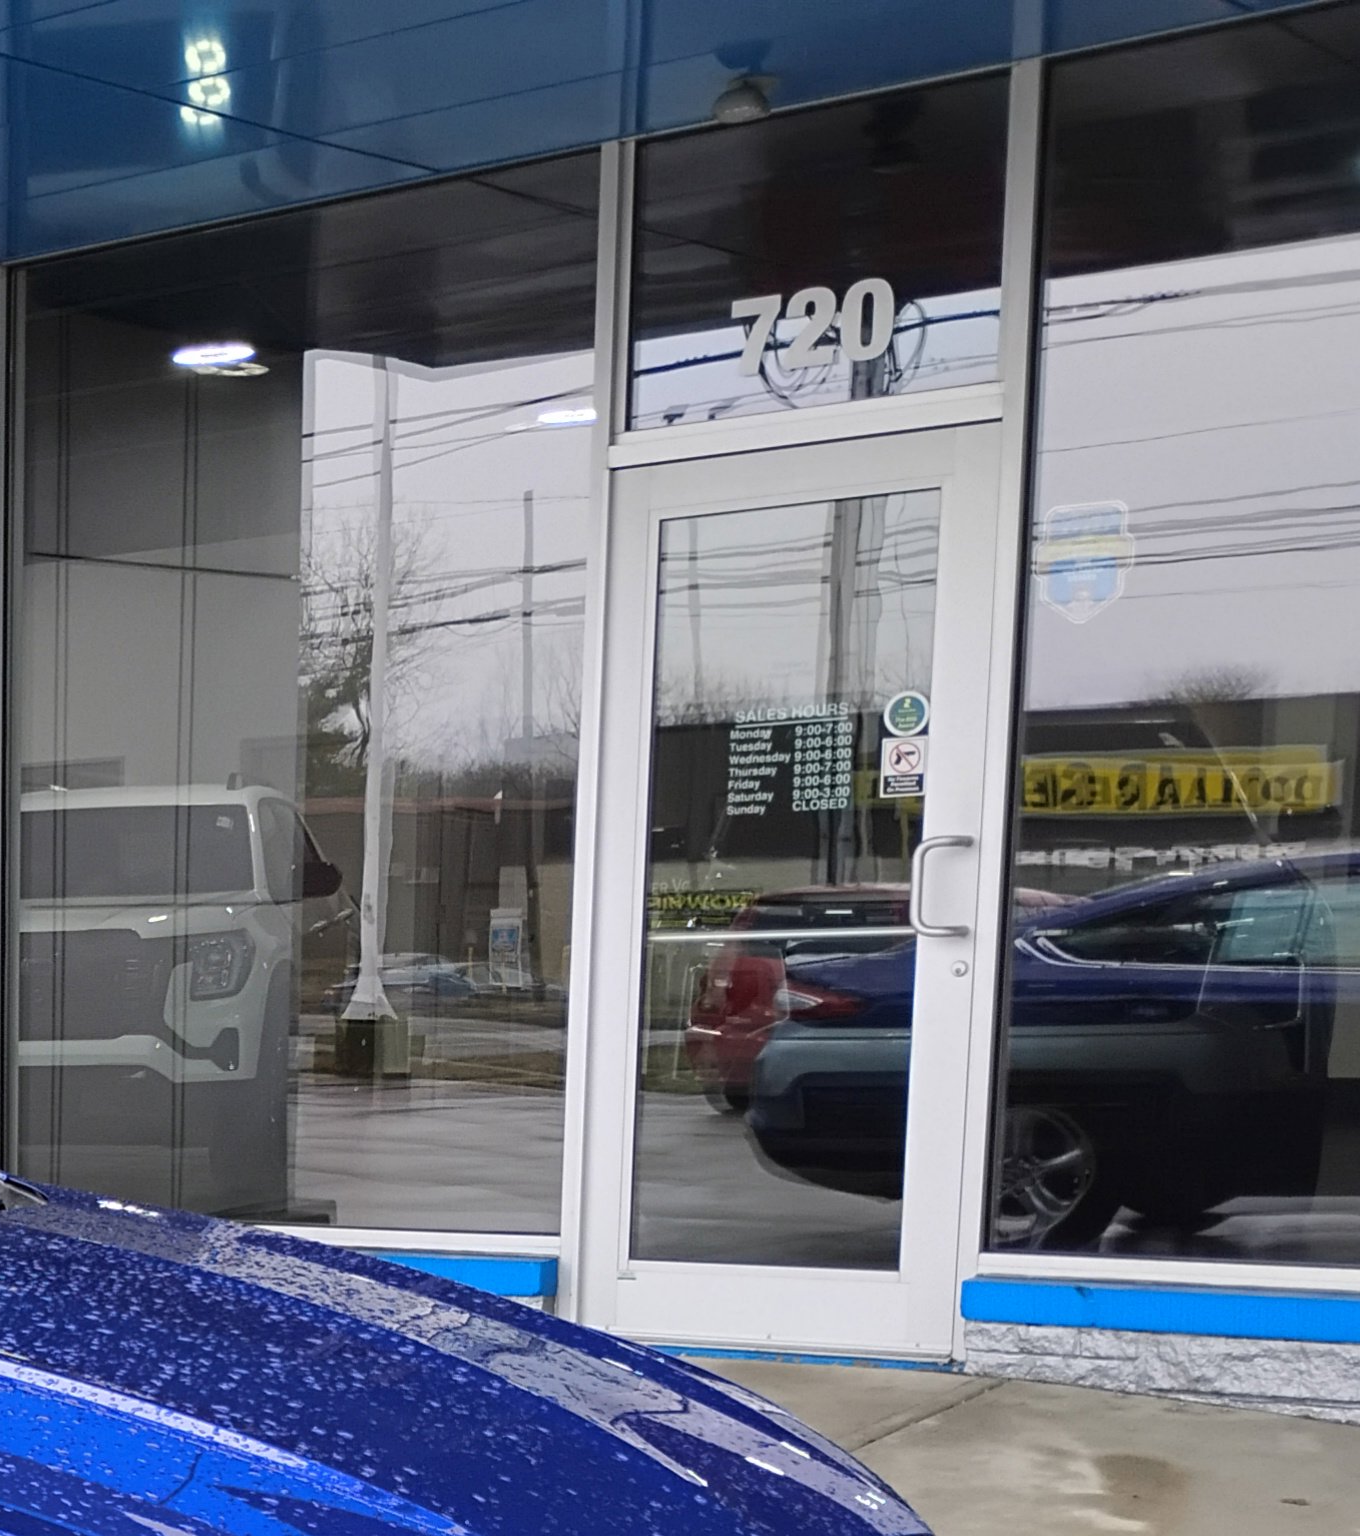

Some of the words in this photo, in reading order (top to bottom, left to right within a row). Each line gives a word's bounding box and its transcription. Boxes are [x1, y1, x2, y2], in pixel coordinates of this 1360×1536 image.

[731, 277, 895, 377] 720
[735, 707, 787, 724] SALES
[791, 702, 849, 719] HOURS
[730, 727, 773, 740] Monday
[794, 722, 853, 736] 9:00-7:00
[729, 741, 773, 753] Tuesday
[794, 735, 853, 749] 9:00-6:00
[728, 751, 791, 765] Wednesday
[794, 748, 852, 762] 9:00-6:00
[728, 765, 778, 777] Thursday
[793, 761, 851, 774] 9:00-7:00
[727, 779, 761, 791] Friday
[793, 774, 851, 787] 9:00-6:00
[727, 791, 774, 803] Saturday
[792, 787, 850, 800] 9:00-3:00
[726, 804, 766, 816] Sunday
[792, 798, 848, 812] CLOSED
